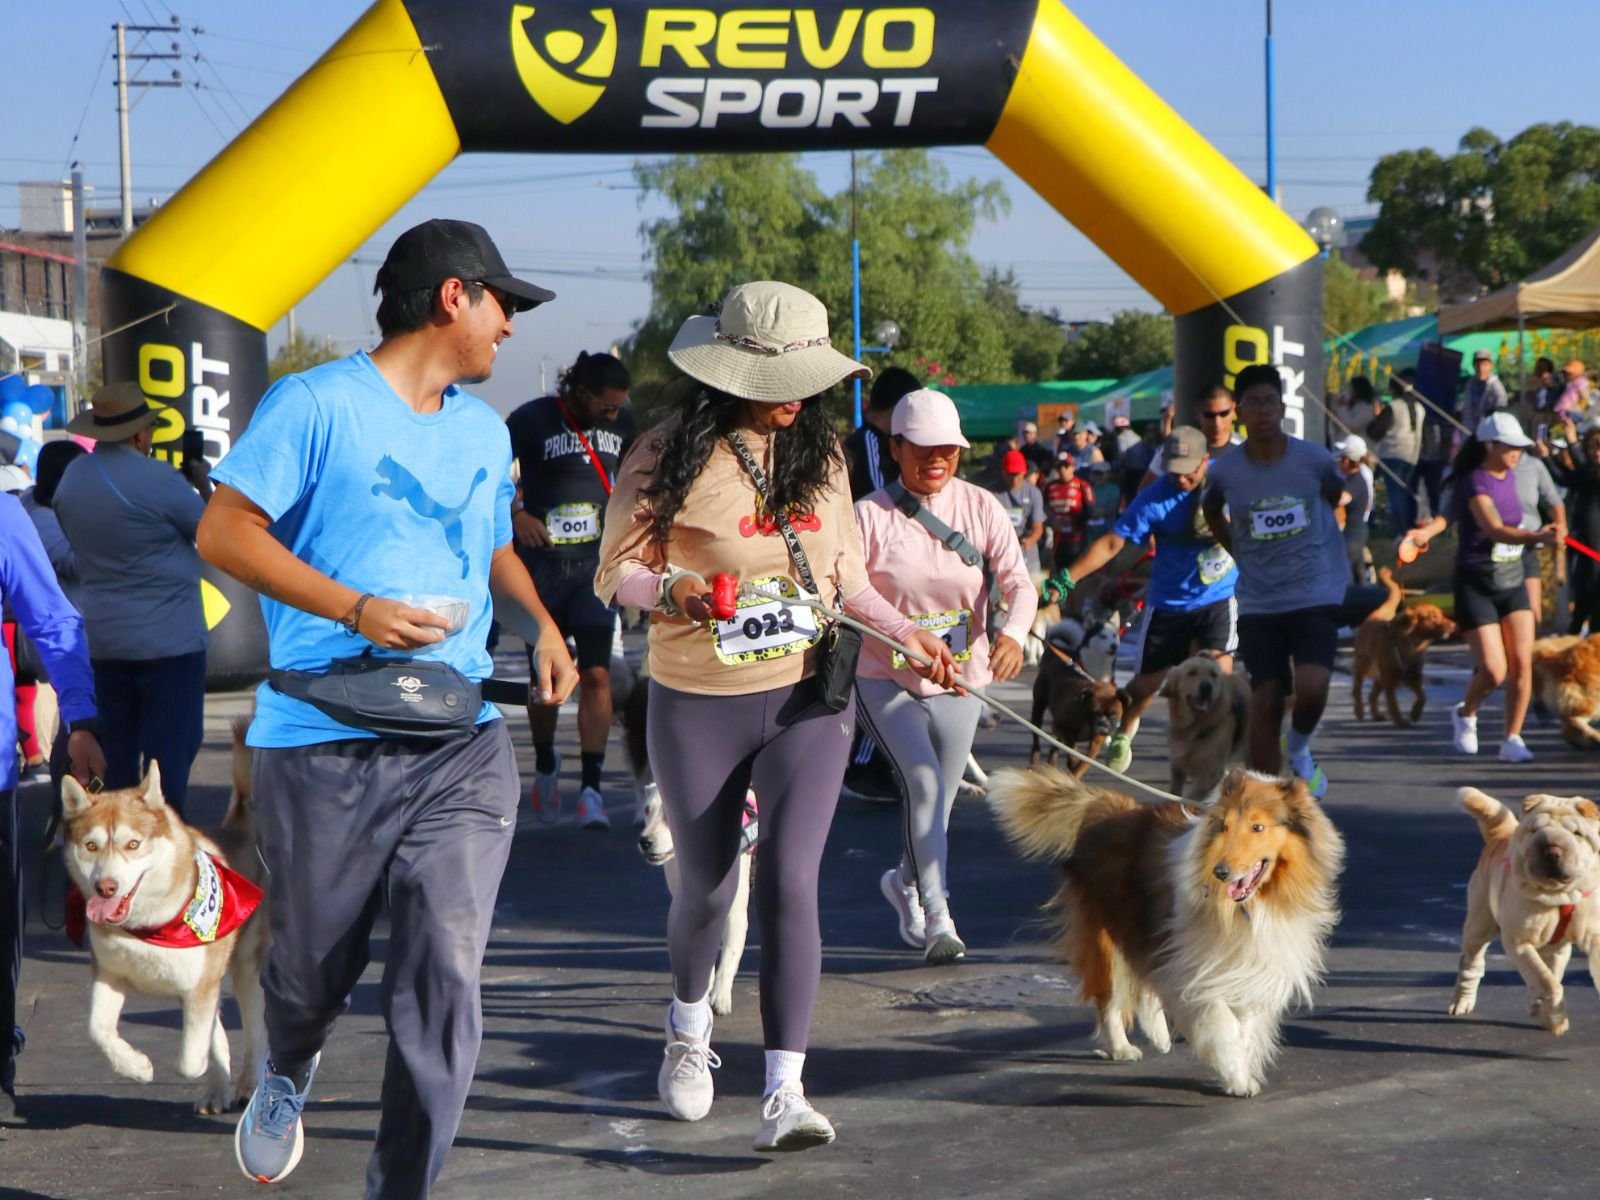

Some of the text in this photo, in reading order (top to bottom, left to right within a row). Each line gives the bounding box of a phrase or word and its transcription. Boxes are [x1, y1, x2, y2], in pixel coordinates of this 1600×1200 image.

[640, 8, 935, 69] REVO
[640, 77, 939, 129] SPORT
[1273, 325, 1304, 440] ORT
[192, 342, 230, 476] ORT
[562, 520, 588, 532] 001
[1264, 512, 1295, 528] 009
[742, 608, 794, 639] 023
